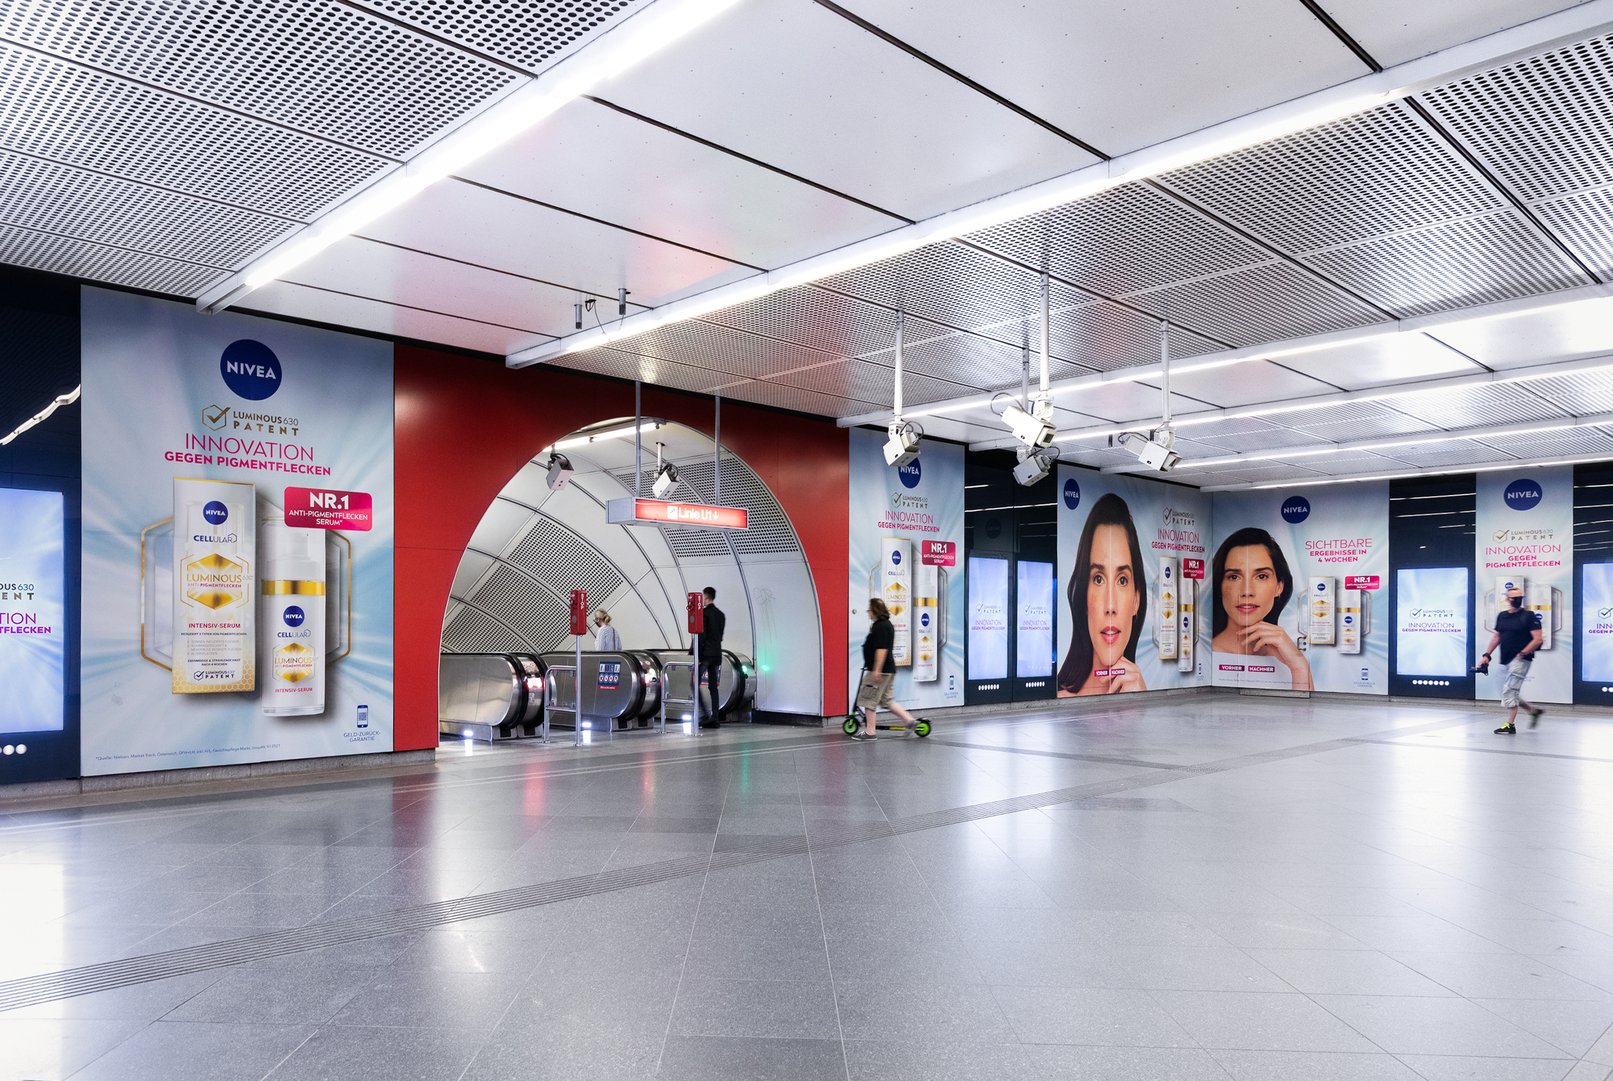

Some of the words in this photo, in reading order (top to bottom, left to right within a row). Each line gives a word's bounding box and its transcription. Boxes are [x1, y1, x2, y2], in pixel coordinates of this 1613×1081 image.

[226, 360, 276, 380] NIVEA
[233, 411, 298, 426] LUMINOUS630
[233, 421, 299, 436] PATENT
[185, 433, 314, 462] INNOVATION
[164, 451, 213, 465] GEGEN
[217, 456, 331, 476] PIGMENTFLECKEN
[900, 466, 919, 475] NIVEA
[1065, 491, 1078, 499] NIVEA
[1508, 491, 1539, 499] NIVEA
[310, 492, 349, 510] NR.1
[206, 509, 225, 517] NIVEA
[289, 509, 368, 520] ANTI-PIGMENTFLECKEN
[679, 507, 700, 519] Linie
[701, 510, 712, 520] U1
[1284, 506, 1308, 514] NIVEA
[885, 510, 934, 524] INNOVATION
[1173, 517, 1195, 526] PATENT
[878, 521, 895, 529] GEGEN
[897, 524, 940, 532] PIGMENTFLECKEN
[193, 534, 233, 544] CELLULAR
[1158, 528, 1200, 543] INNOVATION
[931, 543, 947, 554] NR.1
[1152, 541, 1167, 550] GEGEN
[1167, 543, 1205, 553] PIGMENTFLECKEN
[1305, 538, 1373, 550] SICHTBARE
[1485, 544, 1561, 555] INNOVATION
[187, 573, 242, 583] LUMINOUS
